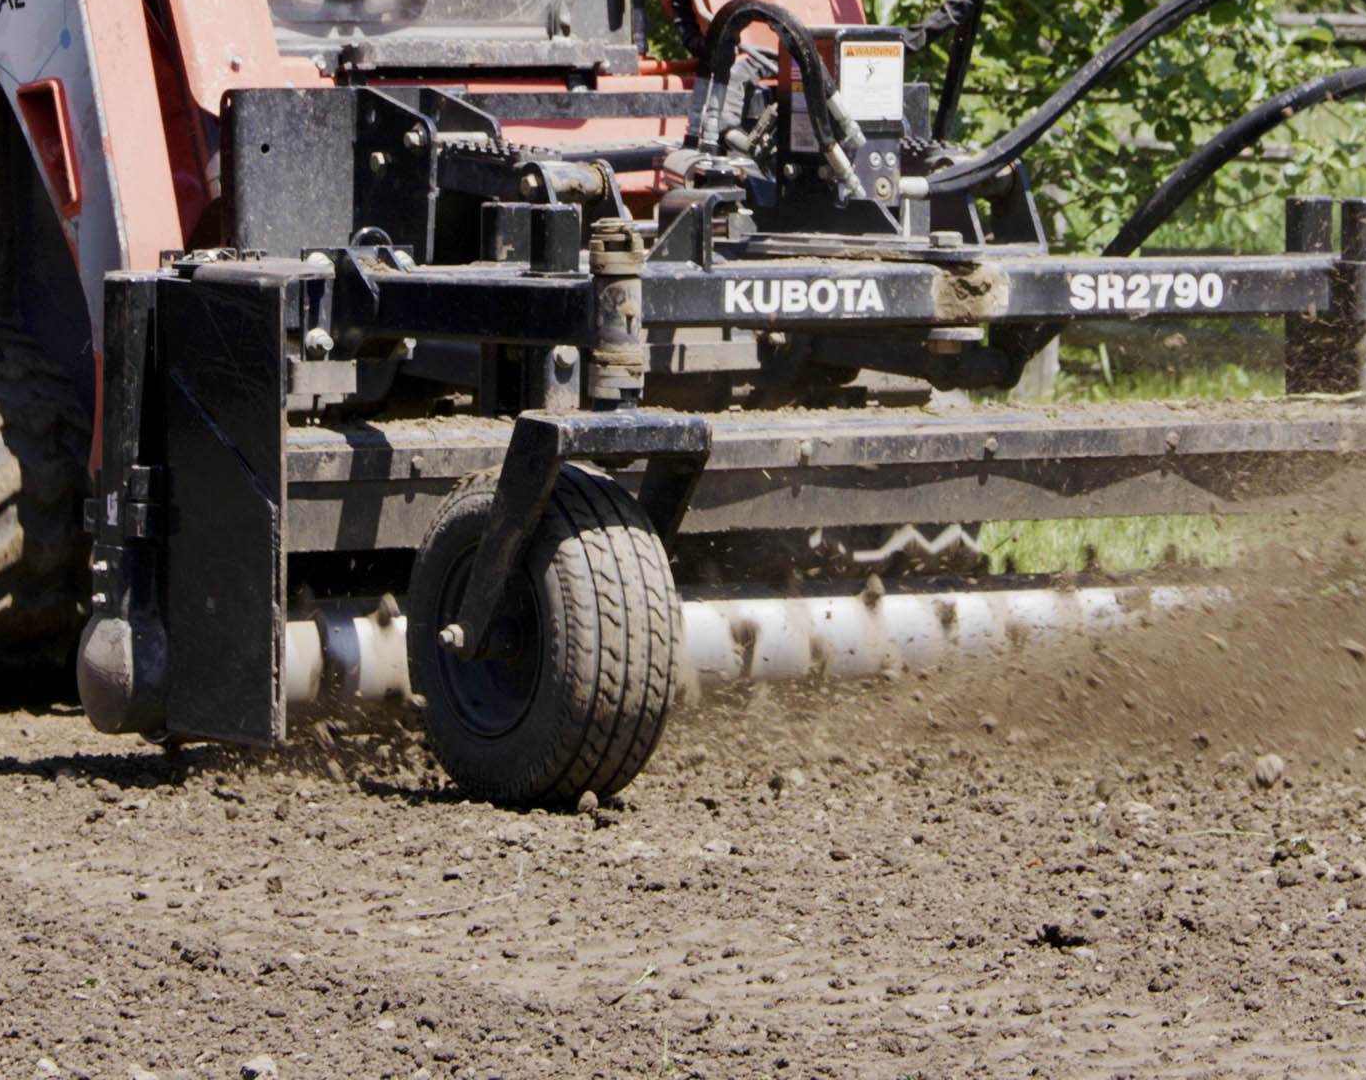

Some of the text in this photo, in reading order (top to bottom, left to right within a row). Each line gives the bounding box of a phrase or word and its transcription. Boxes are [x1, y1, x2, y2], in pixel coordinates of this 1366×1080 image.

[854, 46, 900, 57] WARNING
[724, 272, 1224, 313] KUBOTA SR2790
